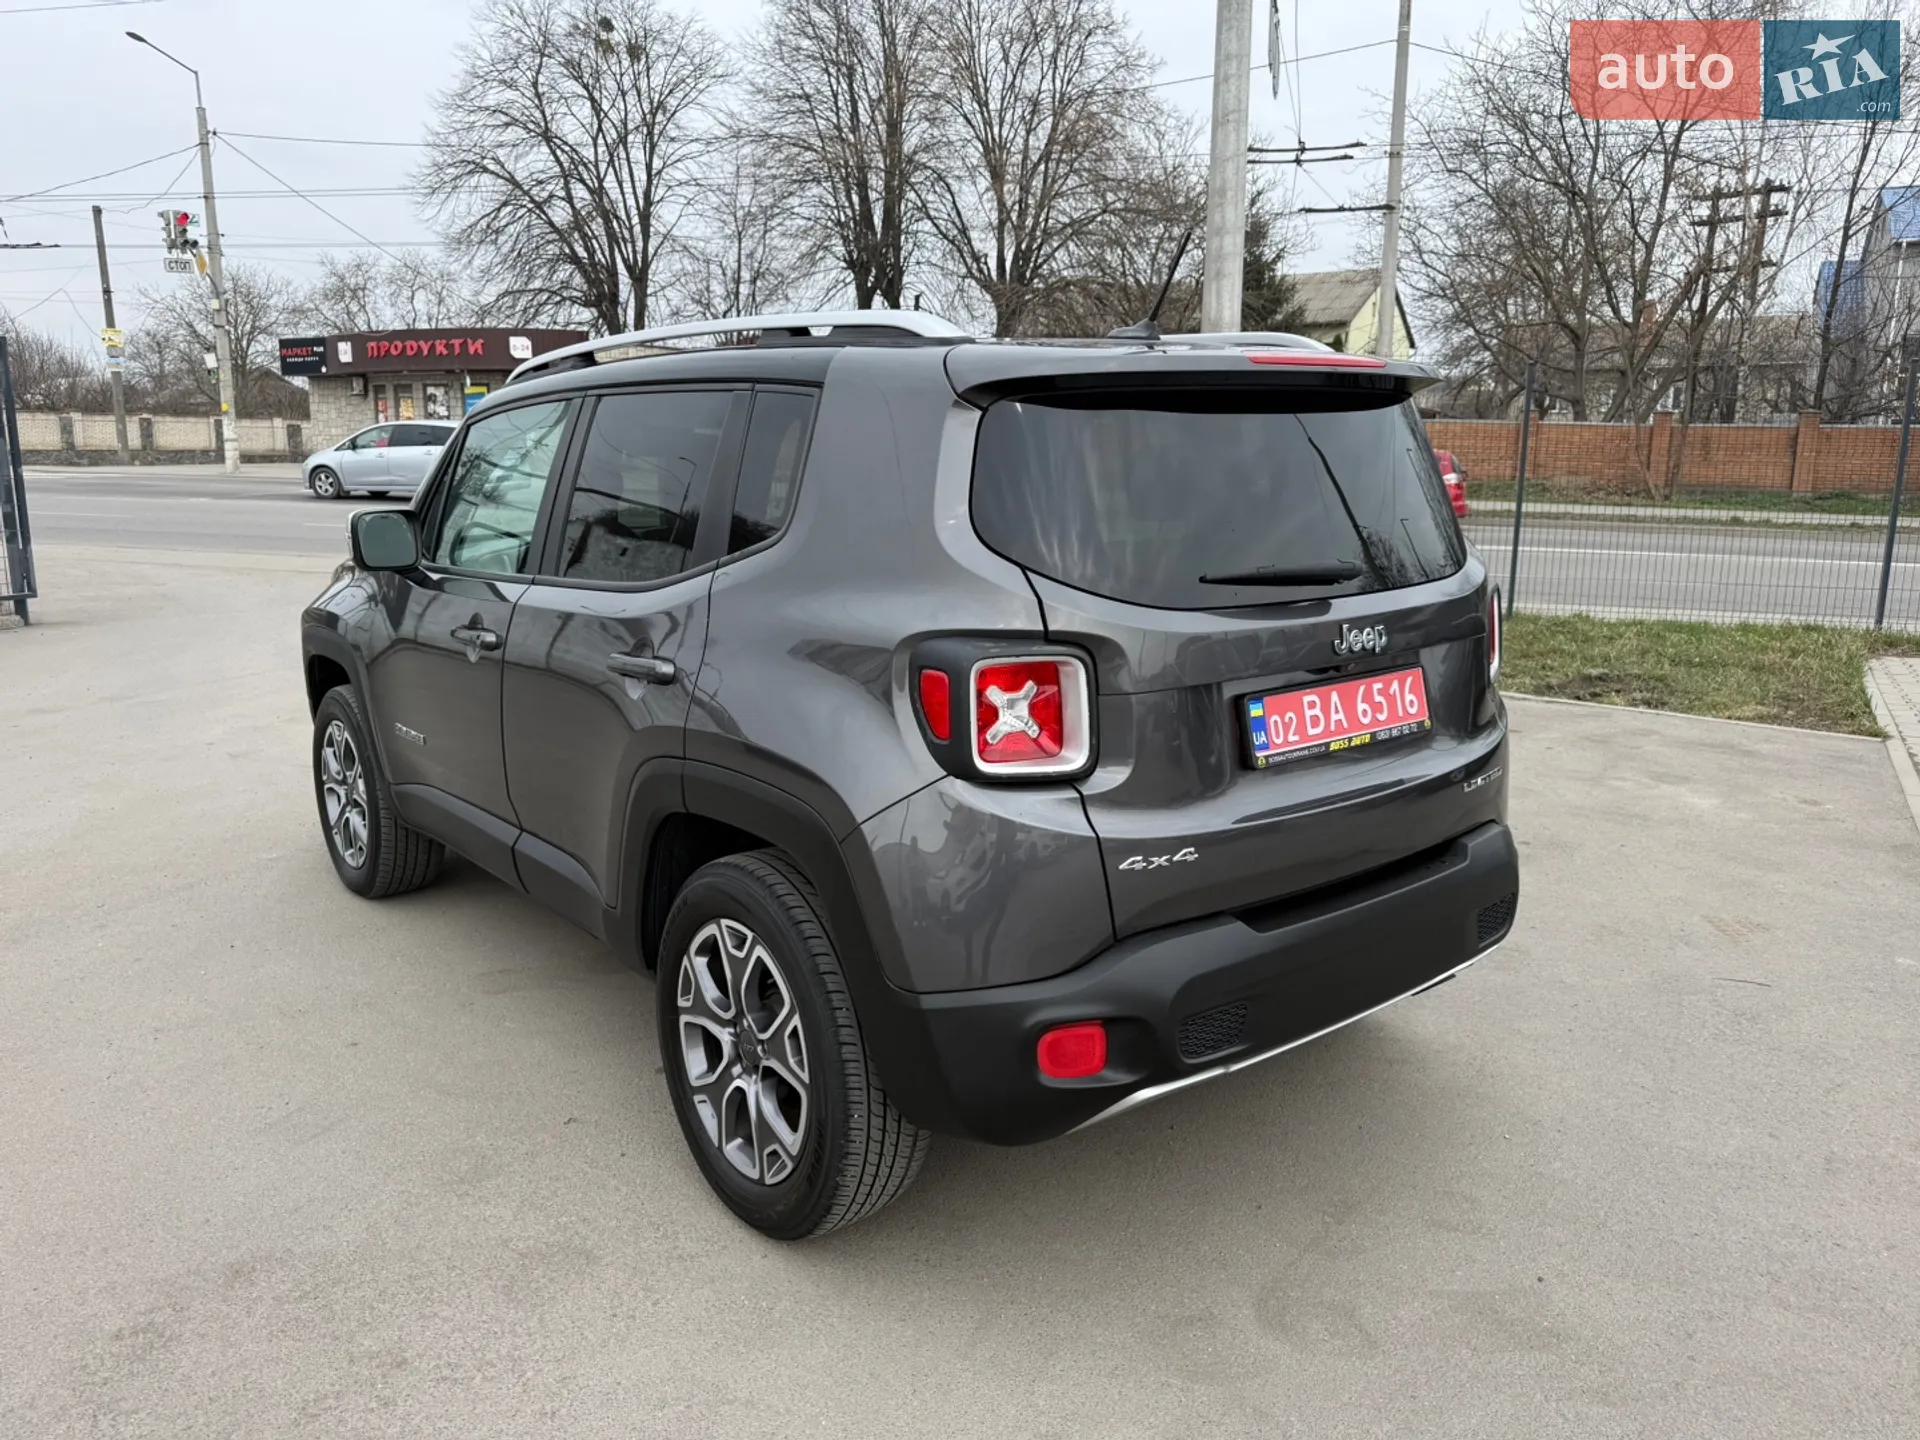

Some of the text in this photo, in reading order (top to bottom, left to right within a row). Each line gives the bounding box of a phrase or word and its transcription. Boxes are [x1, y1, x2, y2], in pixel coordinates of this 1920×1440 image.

[168, 260, 191, 271] СТОП
[1334, 623, 1388, 654] Jeep
[1269, 675, 1419, 745] 02 BA 6516
[1252, 730, 1267, 745] UA
[1118, 847, 1199, 870] 4x4
